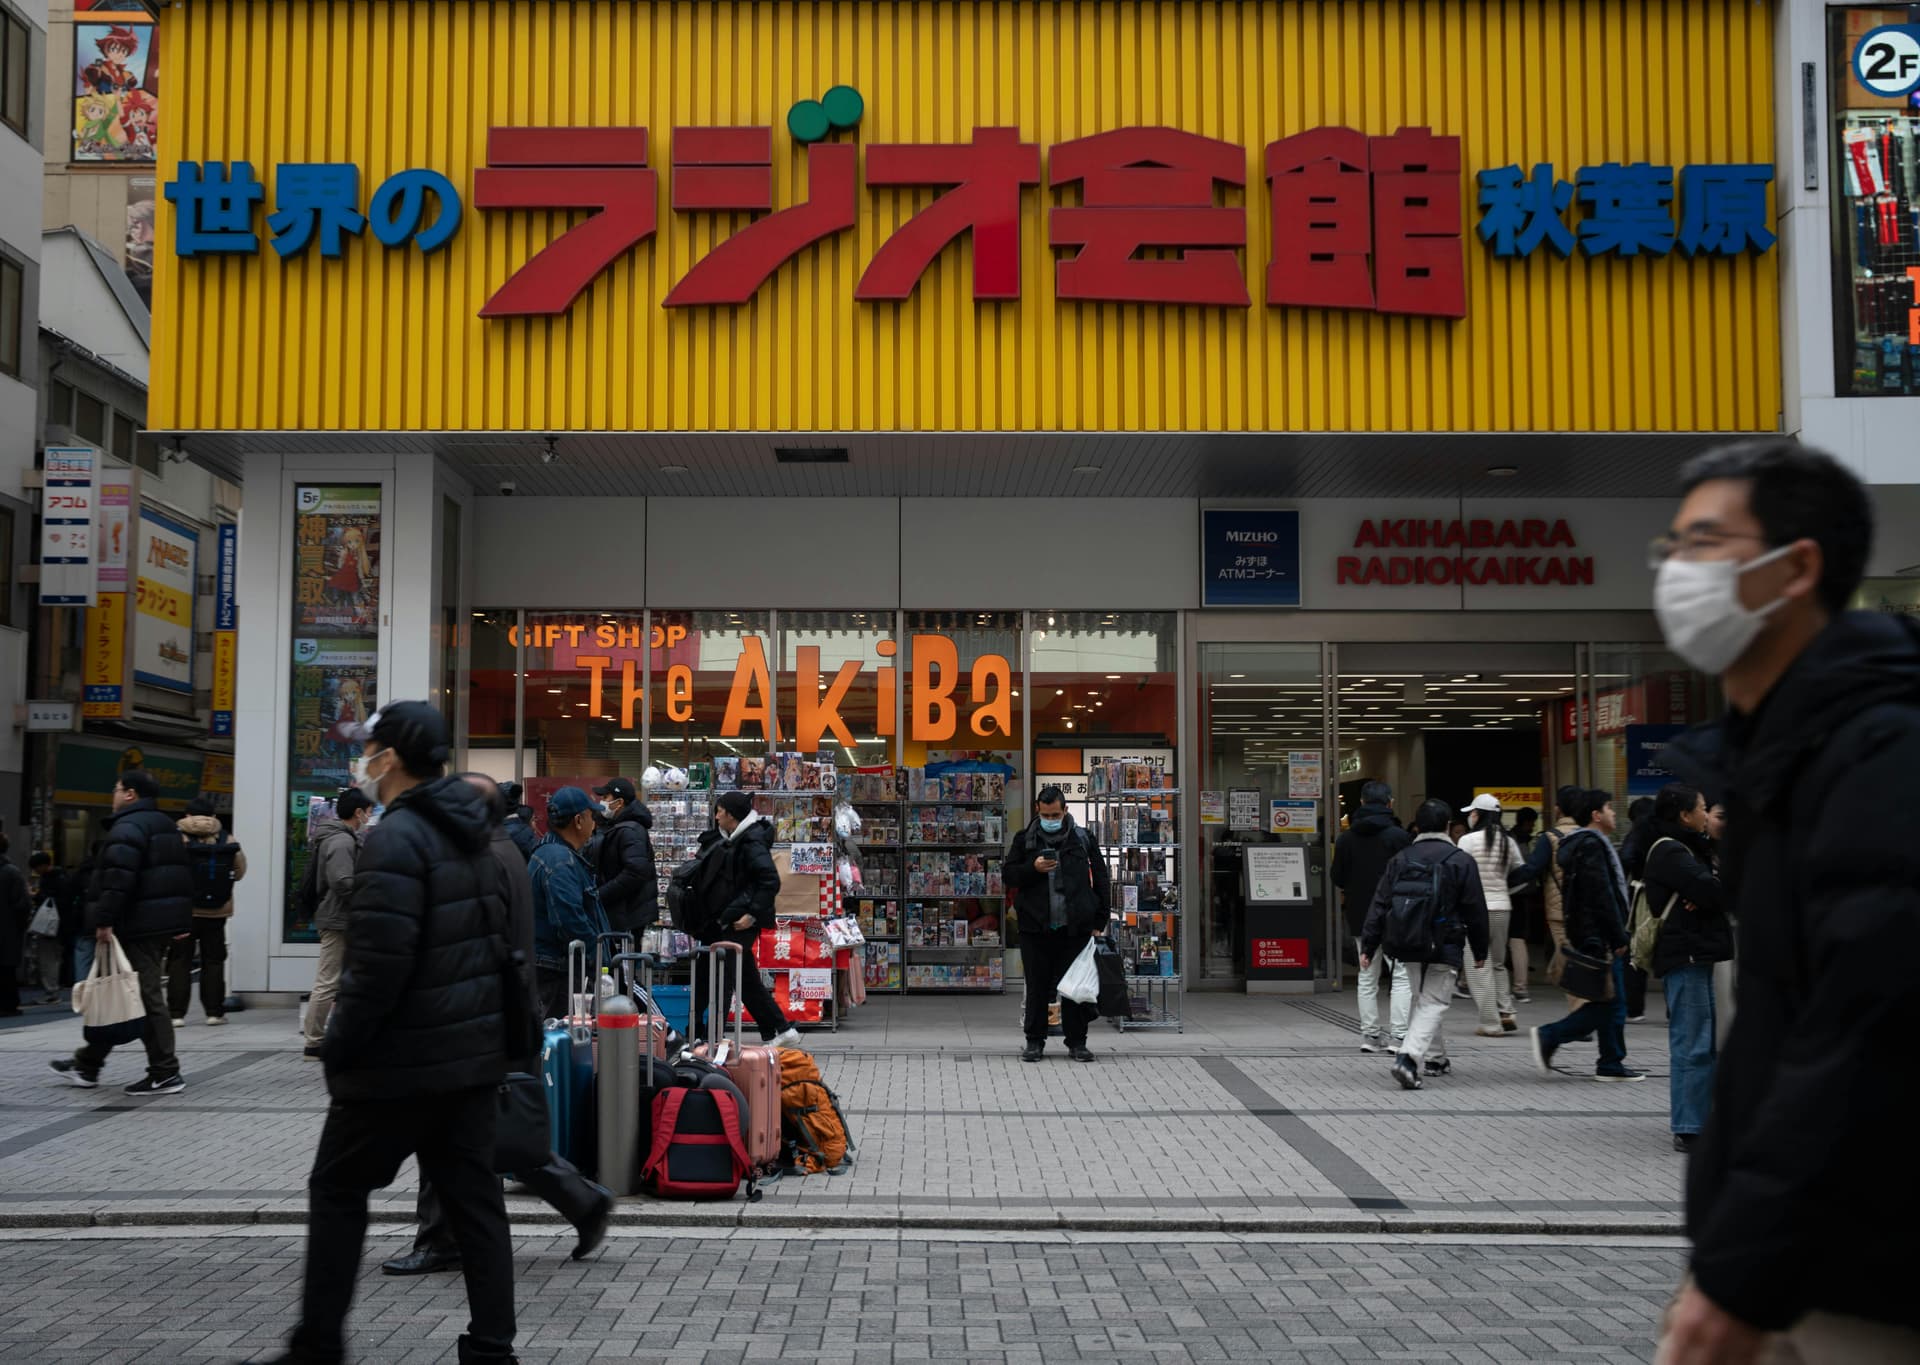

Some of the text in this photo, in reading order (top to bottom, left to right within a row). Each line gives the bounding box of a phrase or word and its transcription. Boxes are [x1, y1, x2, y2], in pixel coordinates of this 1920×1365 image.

[1864, 42, 1919, 80] 2F
[164, 85, 1777, 320] 世界の ラジオ会館 秋葉原
[48, 496, 88, 508] アコム
[303, 492, 319, 504] 5F
[1226, 530, 1278, 542] MIZUHO
[1353, 519, 1577, 548] AKIHABARA
[1235, 555, 1268, 567] みずほ
[1336, 556, 1595, 585] RADIOKAIKAN
[1218, 567, 1285, 580] ATMコーナー
[96, 597, 112, 683] カードラッシュ
[299, 642, 316, 654] 5F
[507, 625, 688, 648] GIFT SHOP
[576, 656, 694, 730] The
[773, 926, 791, 961] 福袋
[800, 990, 825, 999] 1000円
